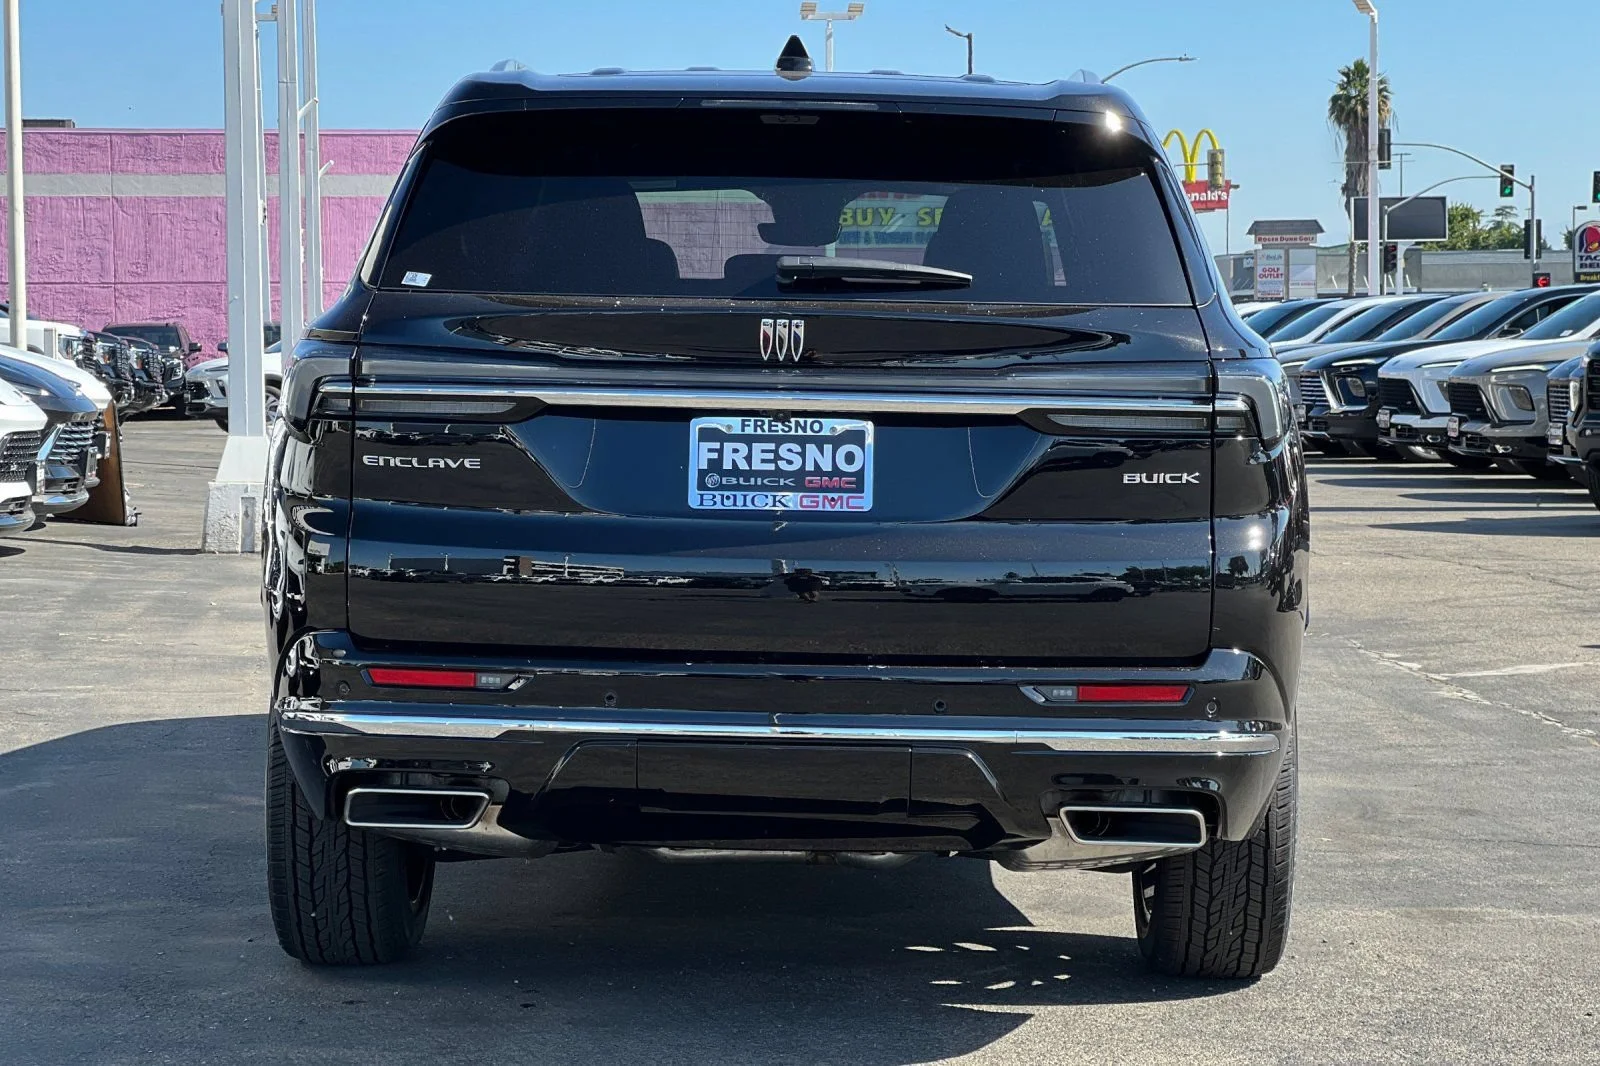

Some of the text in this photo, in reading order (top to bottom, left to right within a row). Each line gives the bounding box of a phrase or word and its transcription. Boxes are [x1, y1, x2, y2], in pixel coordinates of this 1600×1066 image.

[839, 207, 895, 226] BUY
[740, 418, 824, 434] FRESNO
[362, 455, 481, 469] ENCLAVE
[697, 441, 865, 473] FRESNO
[721, 476, 857, 489] BUICK GMC
[1122, 472, 1200, 484] BUICK
[696, 493, 865, 510] BUICK GMC
